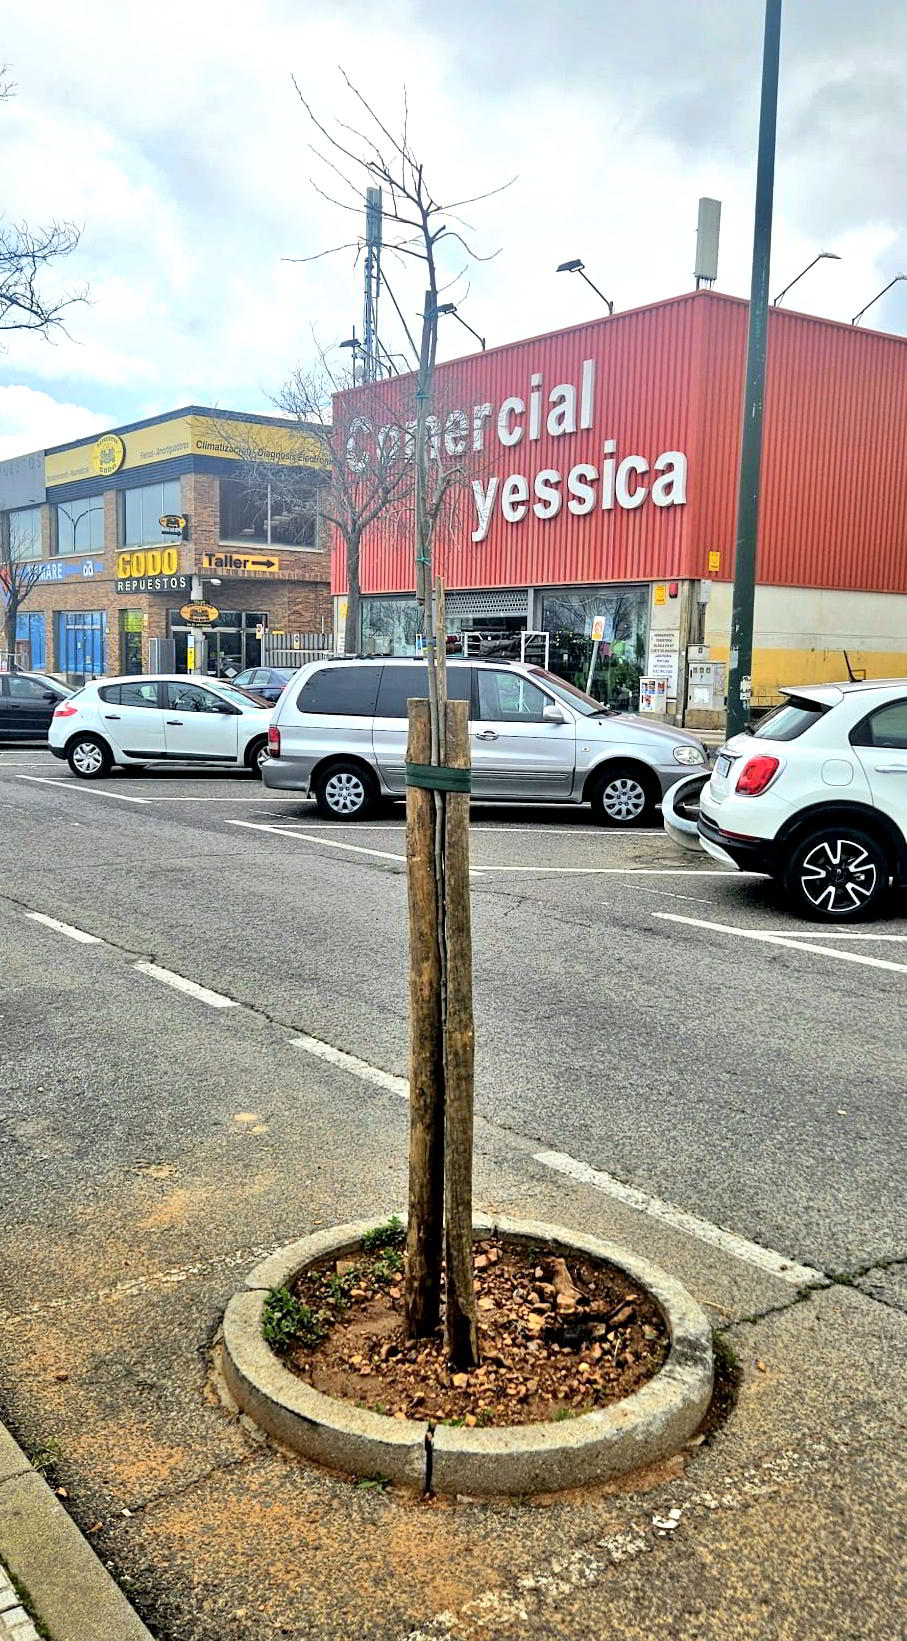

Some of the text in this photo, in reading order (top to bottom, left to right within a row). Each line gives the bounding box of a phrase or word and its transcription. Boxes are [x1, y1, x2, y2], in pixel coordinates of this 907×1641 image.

[345, 359, 596, 473] Comercial
[471, 439, 688, 543] yessica
[116, 548, 179, 580] GODO
[205, 552, 250, 569] Taller
[117, 576, 187, 592] REPUESTOS
